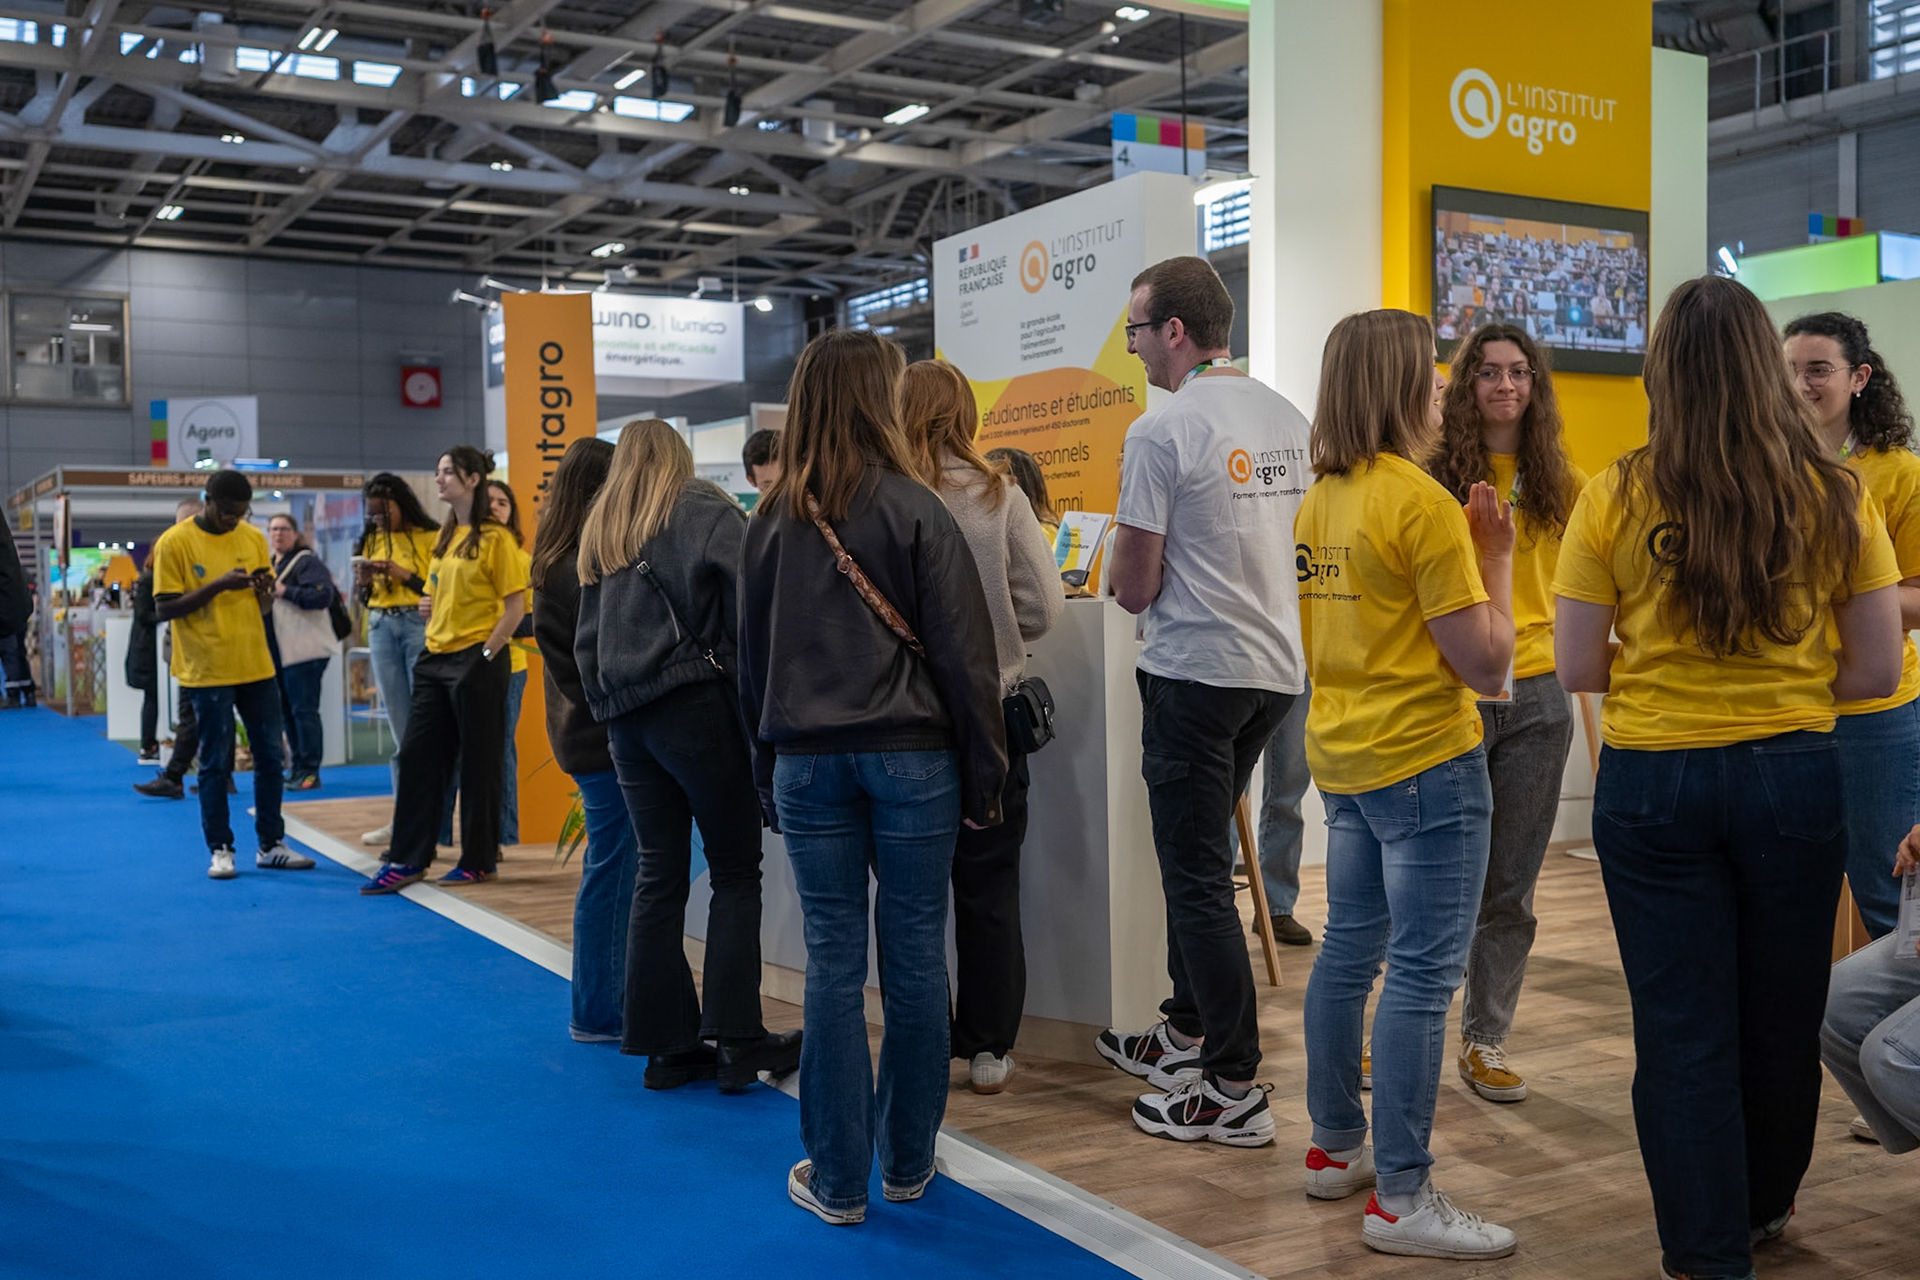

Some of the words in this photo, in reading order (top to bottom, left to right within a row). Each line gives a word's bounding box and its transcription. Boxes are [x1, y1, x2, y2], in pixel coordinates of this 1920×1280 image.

[1507, 82, 1617, 122] L'INSTITUT
[1507, 113, 1577, 155] agro
[1052, 219, 1124, 257] L'INSTITUT
[959, 256, 1007, 280] RÉPUBLIQUE
[1052, 253, 1096, 290] agro
[959, 273, 1004, 296] FRANÇAISE
[982, 402, 1047, 427] étudiantes
[1050, 395, 1063, 416] et
[1067, 385, 1134, 413] étudiants
[187, 424, 236, 444] Agora
[1032, 441, 1090, 467] rsonnels
[260, 475, 303, 487] FRANCE
